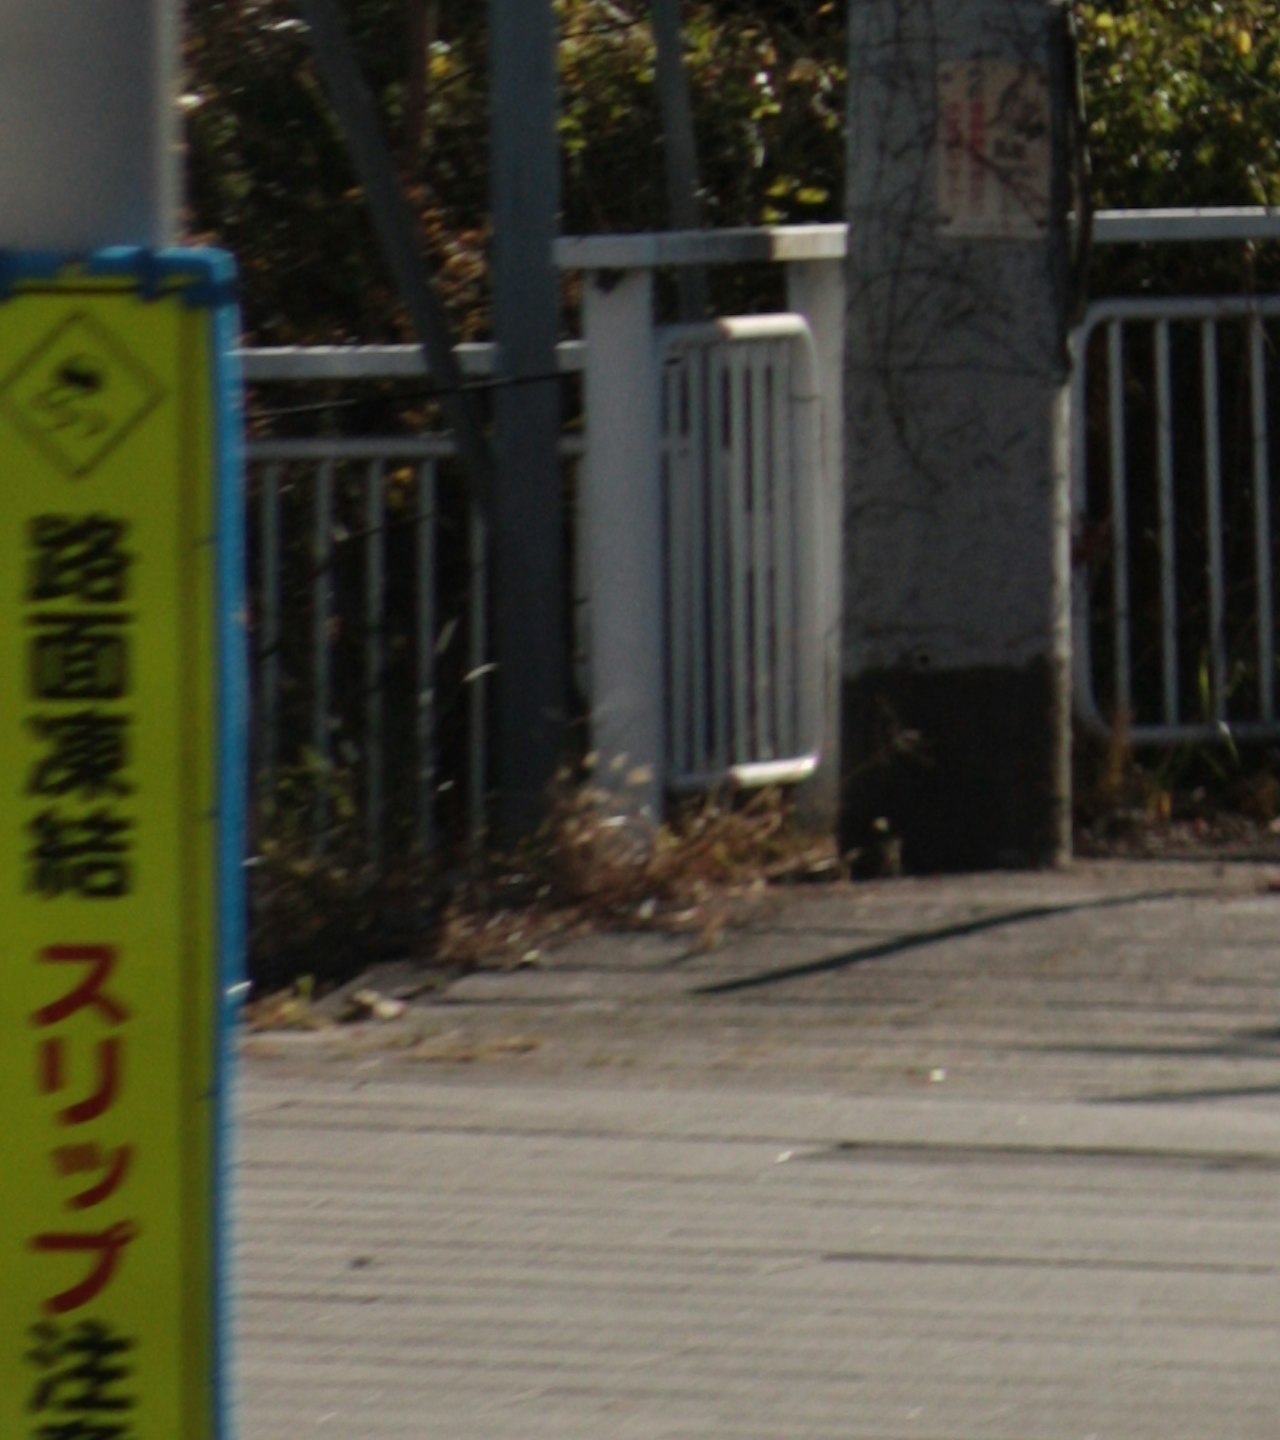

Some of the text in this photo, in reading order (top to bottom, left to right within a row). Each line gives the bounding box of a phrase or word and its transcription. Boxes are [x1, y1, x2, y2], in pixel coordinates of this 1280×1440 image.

[24, 940, 140, 1440] スリップ注
